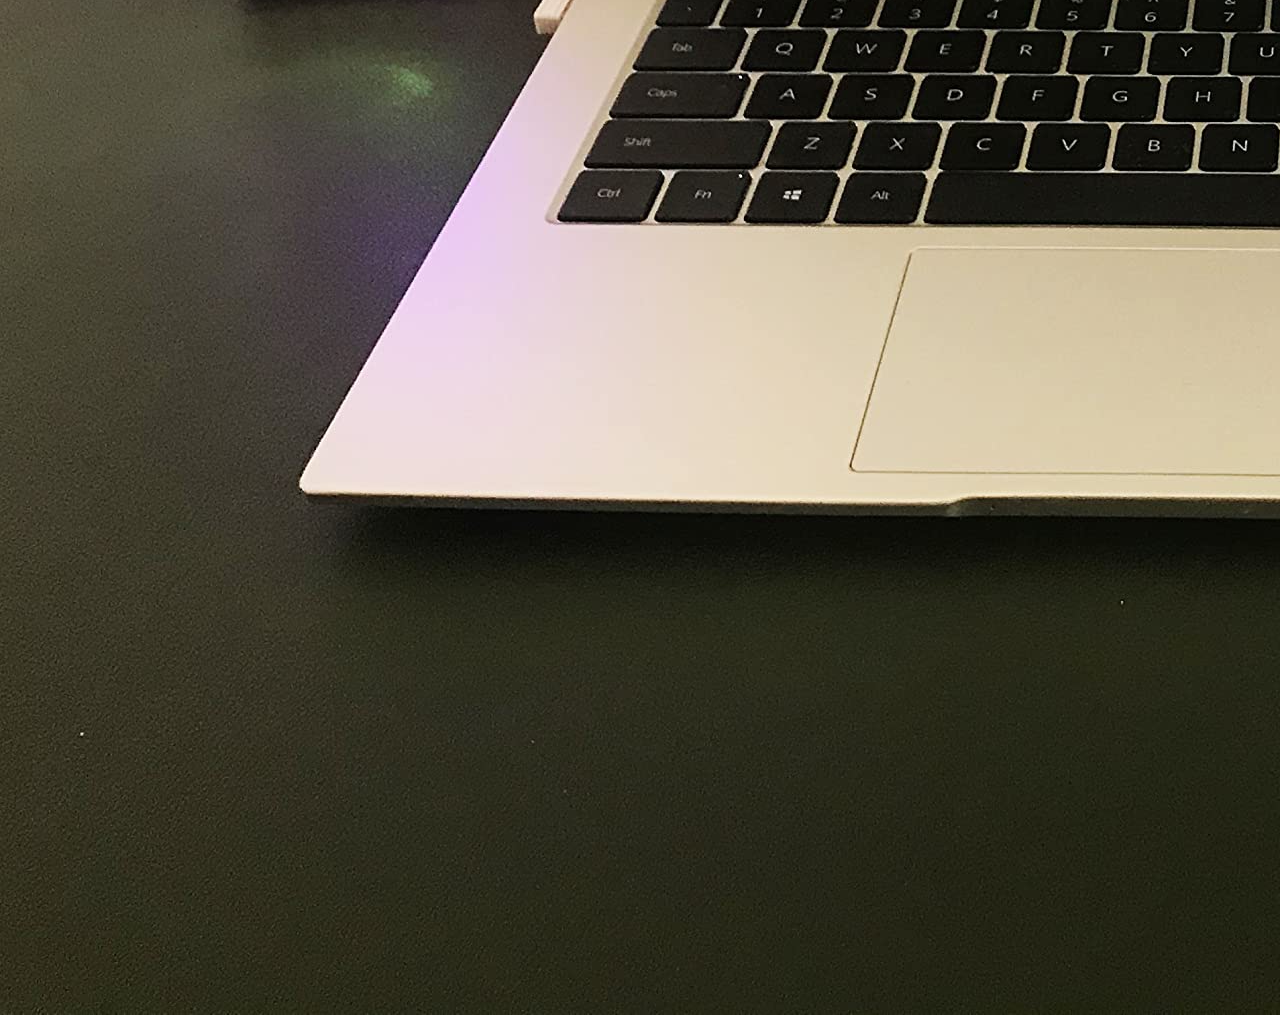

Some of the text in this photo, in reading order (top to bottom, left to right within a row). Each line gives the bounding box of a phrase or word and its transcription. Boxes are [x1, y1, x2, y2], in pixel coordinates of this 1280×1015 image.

[756, 7, 763, 19] 1
[830, 8, 844, 19] 2
[909, 8, 922, 20] 3
[986, 9, 999, 20] 4
[1066, 10, 1078, 22] 5
[1144, 11, 1157, 23] 6
[1223, 11, 1235, 23] 7
[671, 42, 693, 52] Tab
[775, 42, 794, 56] Q
[856, 43, 878, 55] W
[939, 43, 952, 55] E
[1019, 44, 1033, 56] R
[1101, 45, 1114, 57] T
[1180, 46, 1193, 58] Y
[1259, 46, 1275, 58] U
[647, 88, 678, 99] Caps
[779, 88, 796, 100] A
[864, 88, 877, 101] S
[946, 88, 964, 101] D
[1031, 89, 1045, 102] F
[1112, 90, 1128, 102] G
[1195, 90, 1211, 103] H
[623, 137, 652, 147] Shift
[803, 136, 821, 150] Z
[889, 137, 906, 151] X
[976, 137, 992, 151] C
[1061, 138, 1078, 151] V
[1147, 139, 1161, 152] B
[1232, 139, 1248, 152] N
[597, 188, 621, 198] Ctrl
[694, 189, 712, 199] Fn
[870, 190, 889, 200] Alt
